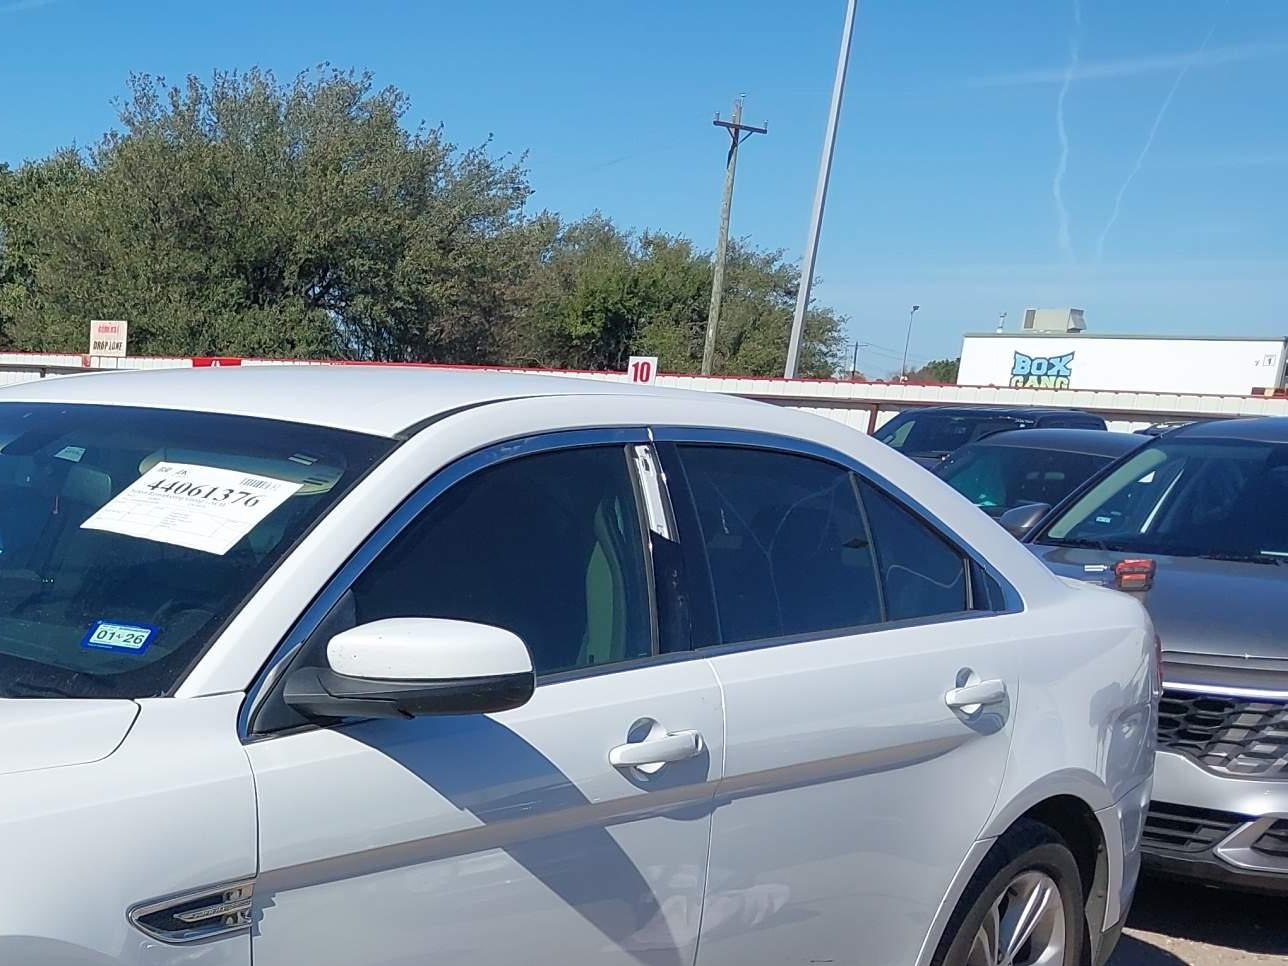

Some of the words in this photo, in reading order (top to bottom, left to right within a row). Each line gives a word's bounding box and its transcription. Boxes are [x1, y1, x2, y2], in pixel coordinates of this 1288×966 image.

[631, 361, 651, 383] 10
[1011, 350, 1075, 376] BOX
[147, 479, 263, 507] 44061376
[96, 630, 116, 641] 01
[122, 633, 145, 645] 26
